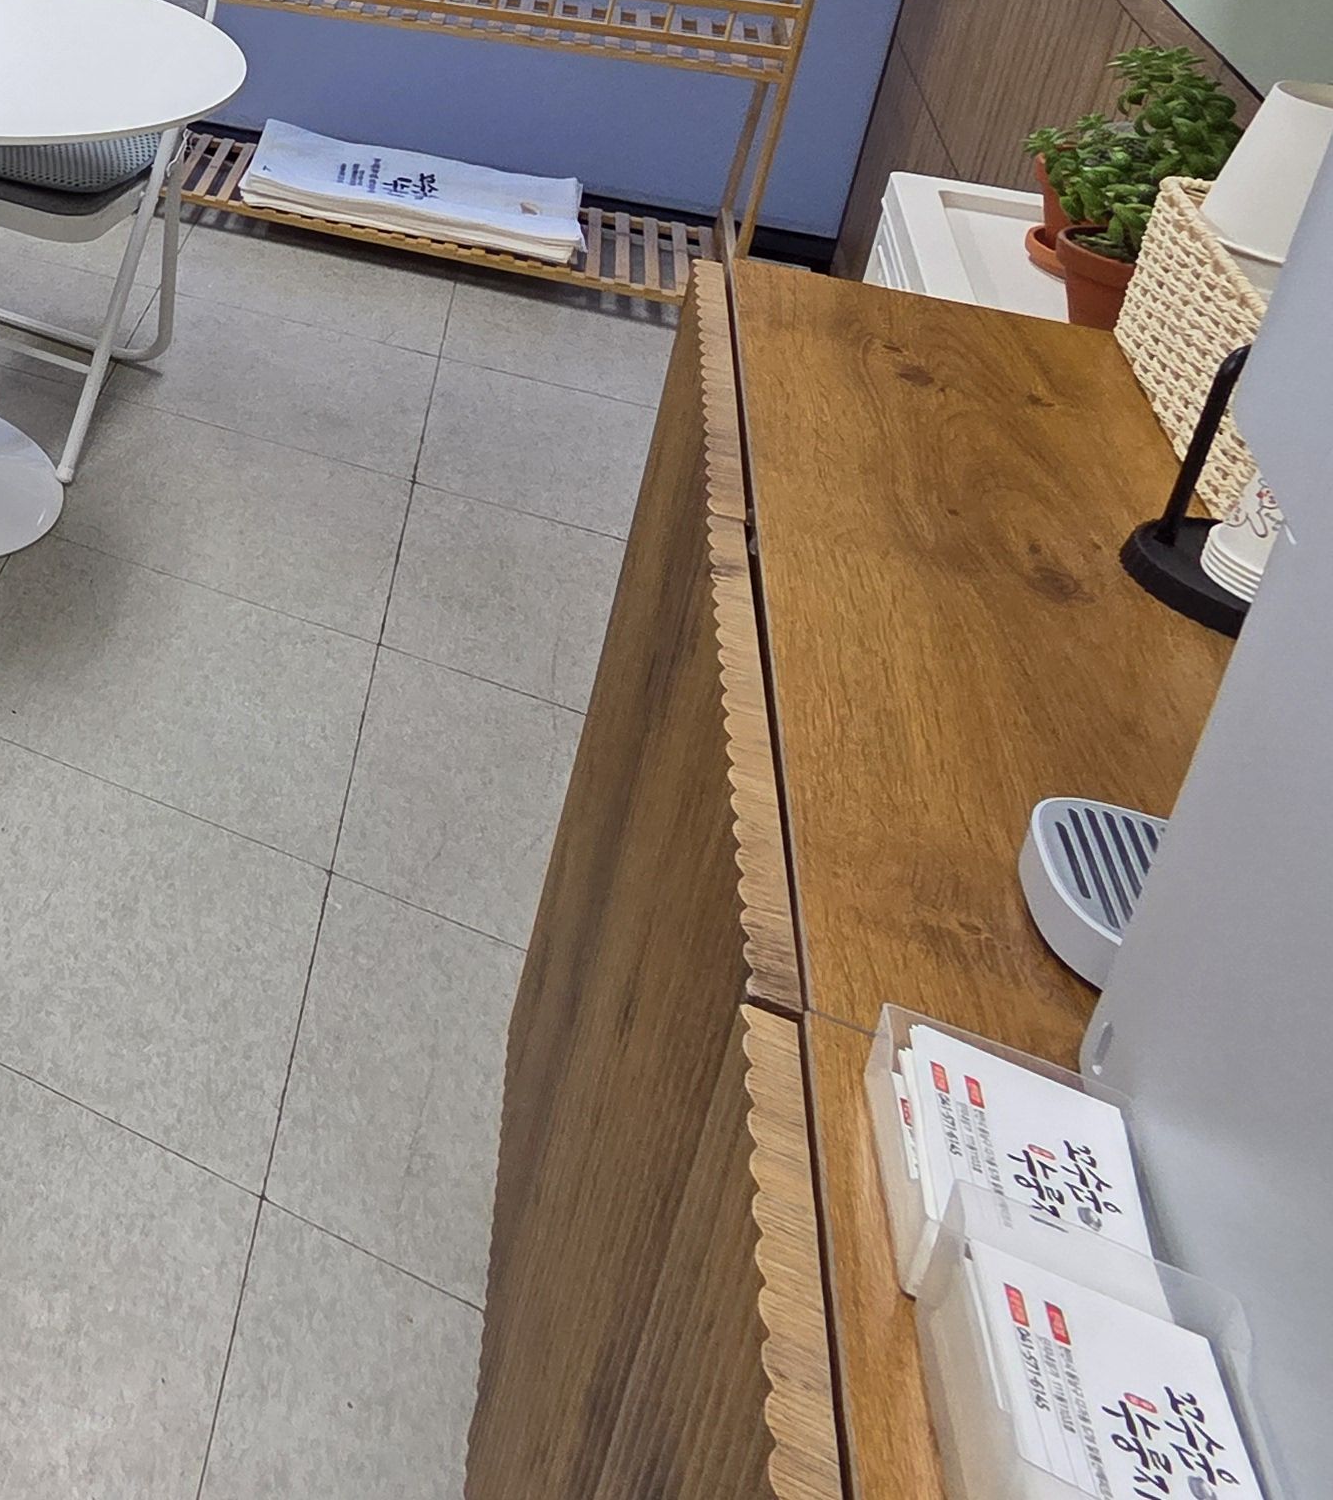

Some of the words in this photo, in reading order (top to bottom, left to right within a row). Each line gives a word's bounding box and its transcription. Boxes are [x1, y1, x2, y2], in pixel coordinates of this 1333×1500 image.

[1006, 1149, 1070, 1234] 누룽지
[1063, 1139, 1123, 1215] 꼬수운
[1015, 1325, 1051, 1412] 041-571-6145
[1163, 1385, 1241, 1486] 꼬수운
